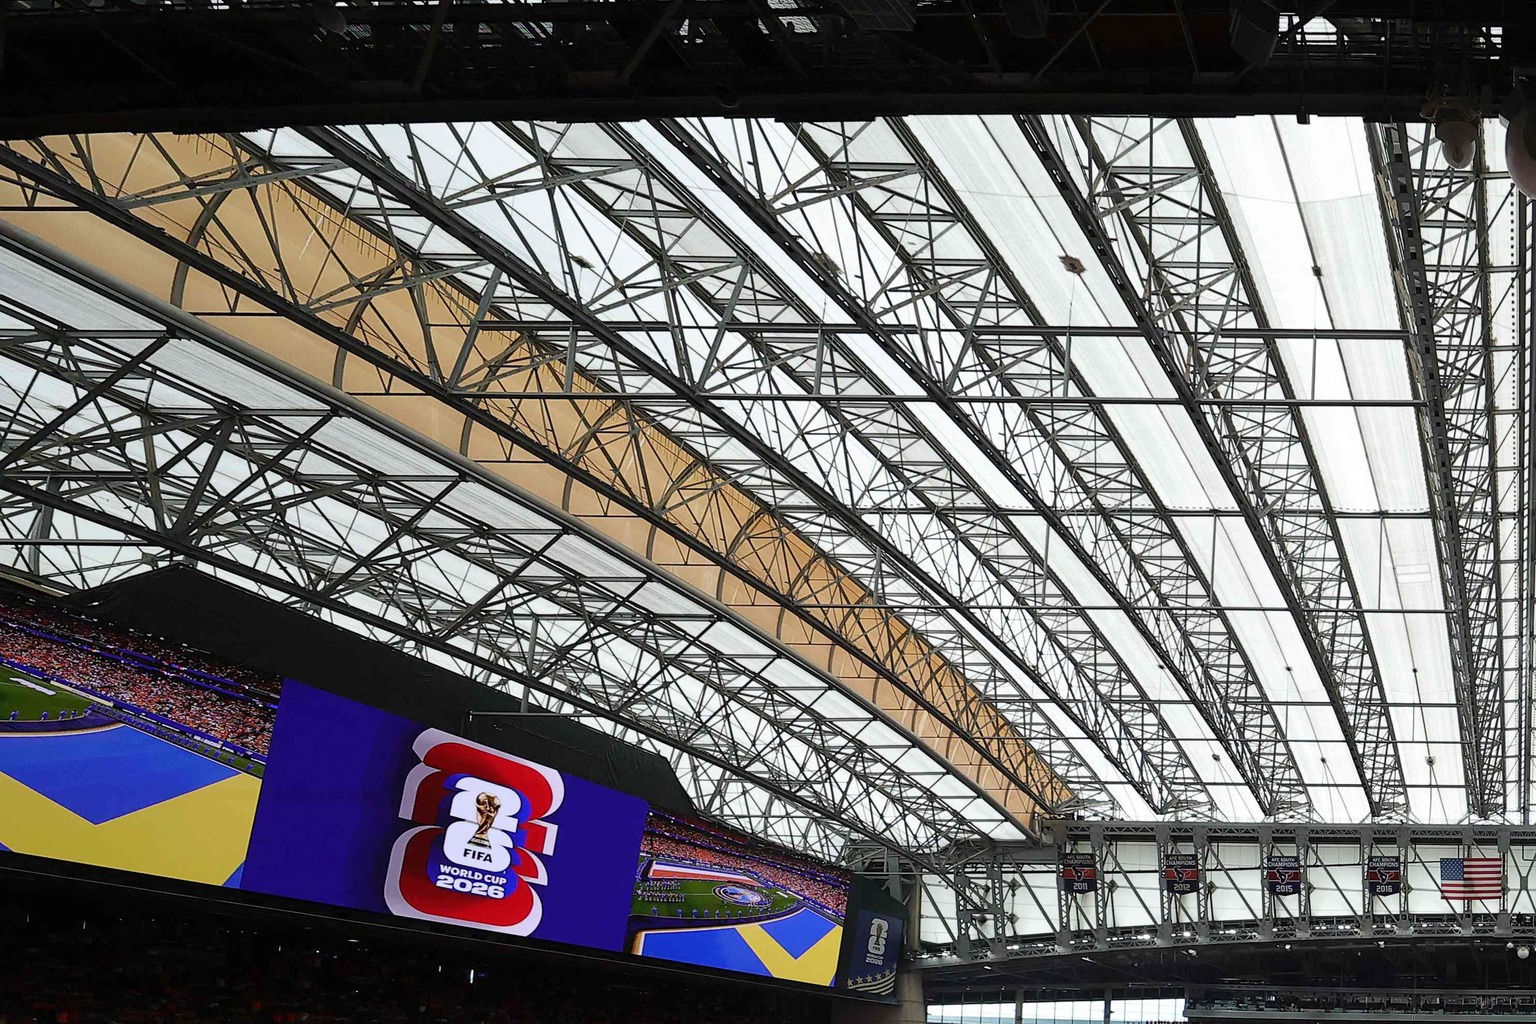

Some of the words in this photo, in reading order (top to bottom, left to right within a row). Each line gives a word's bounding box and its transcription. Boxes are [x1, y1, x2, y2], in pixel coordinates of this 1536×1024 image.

[463, 848, 493, 863] FIFA
[440, 864, 482, 880] WORLD
[484, 874, 507, 885] CUP
[436, 874, 505, 899] 2026
[1073, 882, 1088, 890] 2011
[1173, 883, 1190, 891] 2012
[1275, 885, 1293, 893] 2015
[1376, 885, 1393, 893] 2016
[865, 957, 883, 966] 2026
